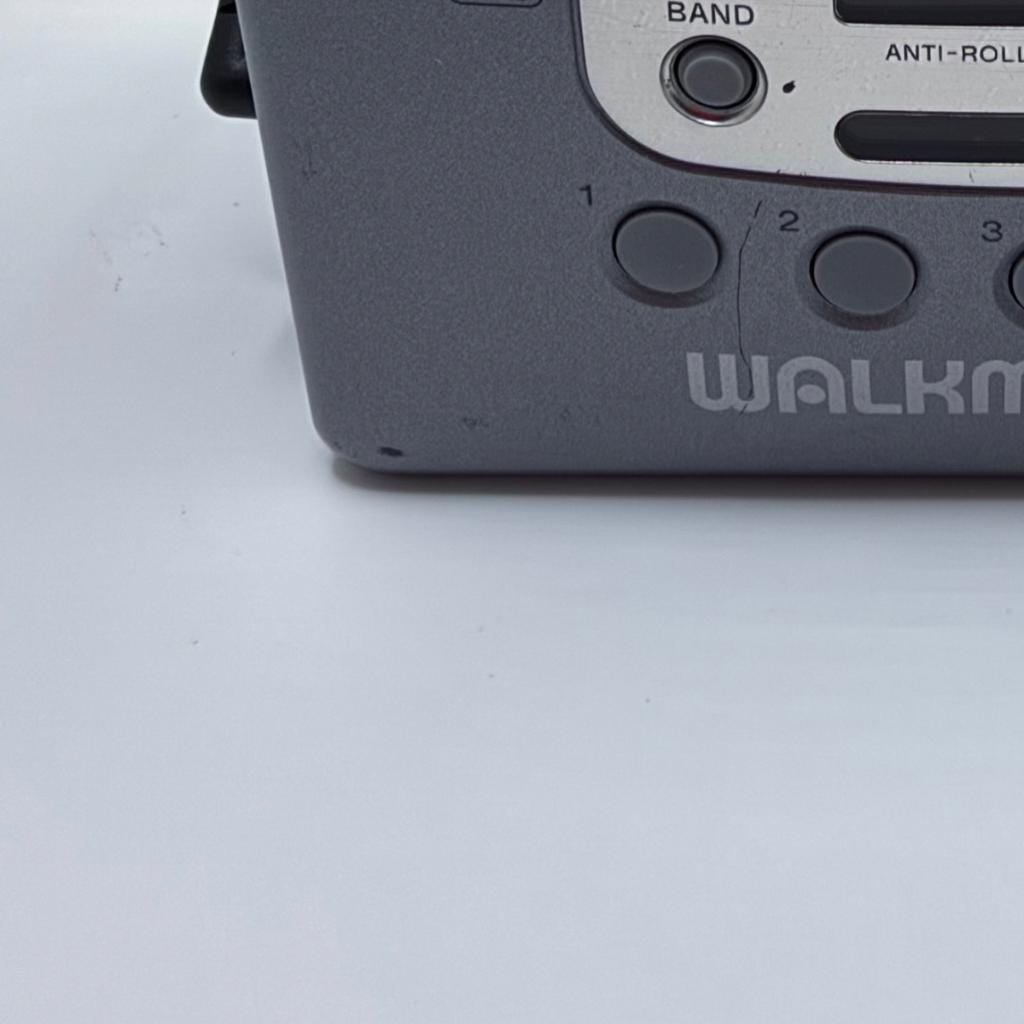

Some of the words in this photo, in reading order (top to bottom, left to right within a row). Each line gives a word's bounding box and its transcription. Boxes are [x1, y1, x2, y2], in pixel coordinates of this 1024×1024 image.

[667, 0, 755, 26] BAND
[579, 184, 593, 206] 1
[778, 210, 800, 233] 2
[981, 220, 1003, 243] 3
